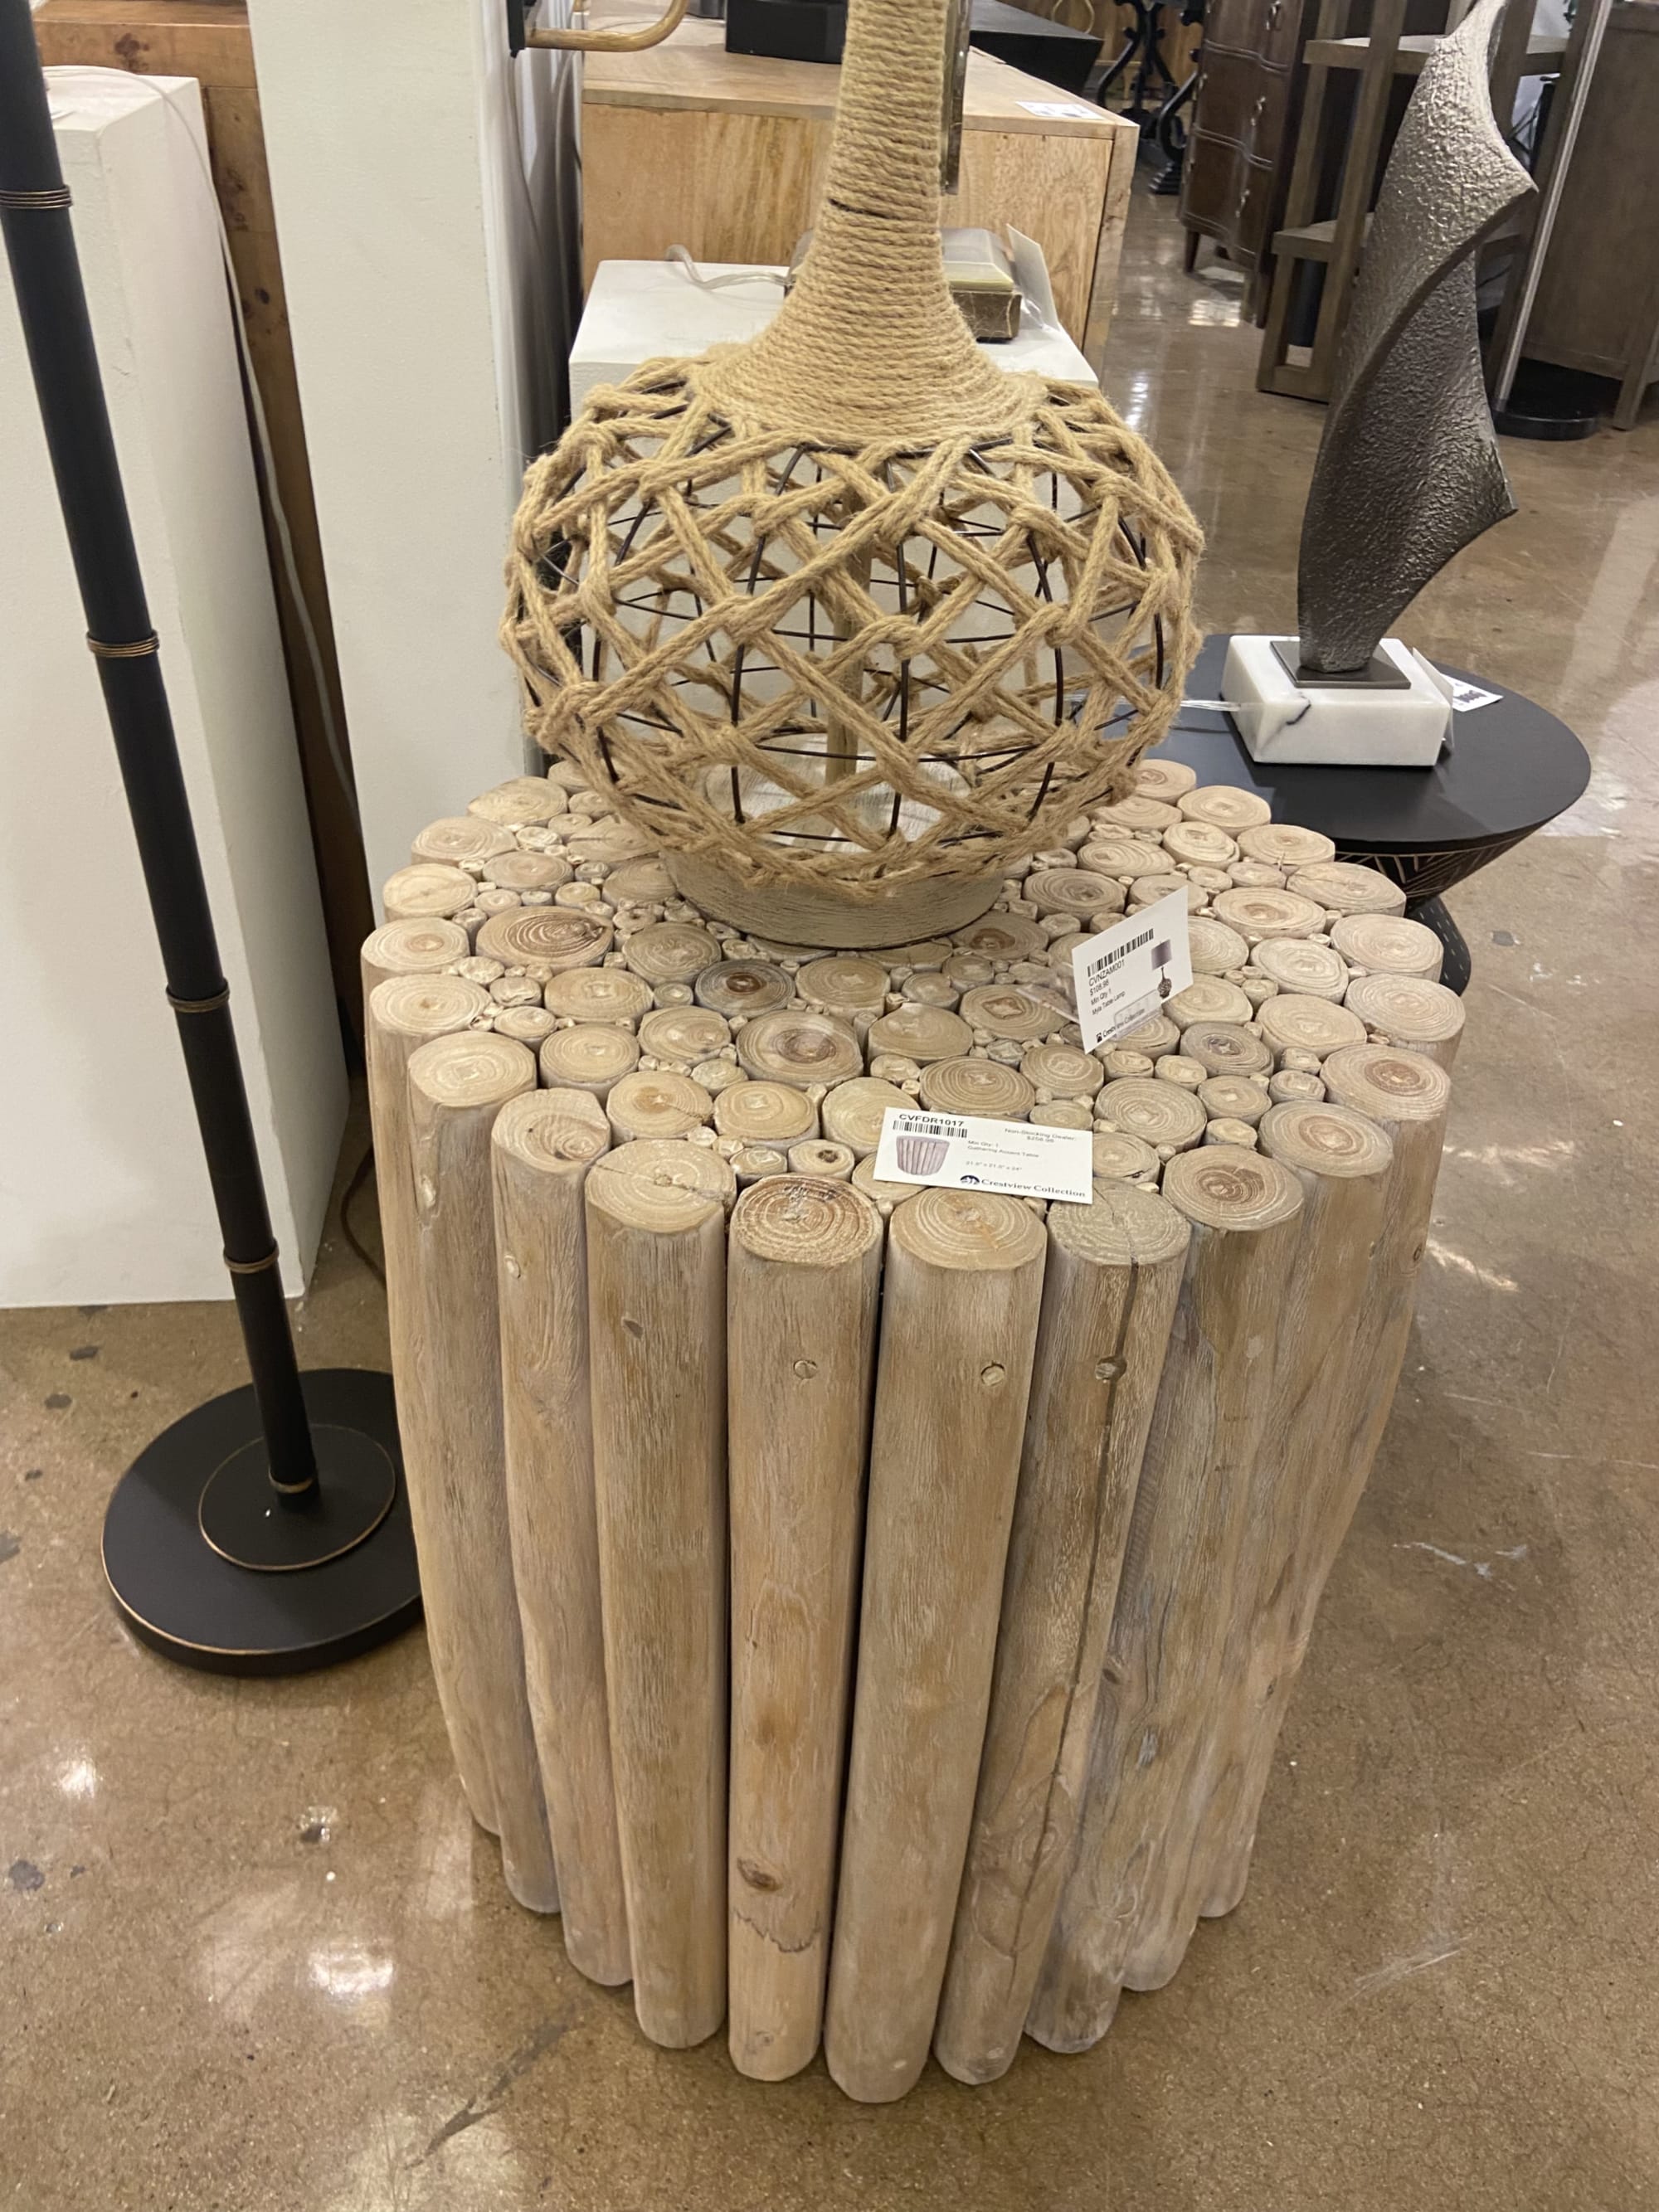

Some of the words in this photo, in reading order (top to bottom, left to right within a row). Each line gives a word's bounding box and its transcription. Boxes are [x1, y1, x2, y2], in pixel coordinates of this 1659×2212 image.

[899, 1114, 965, 1127] CVFDR1017
[981, 1179, 1032, 1190] Crestview
[1034, 1184, 1086, 1198] Collection
